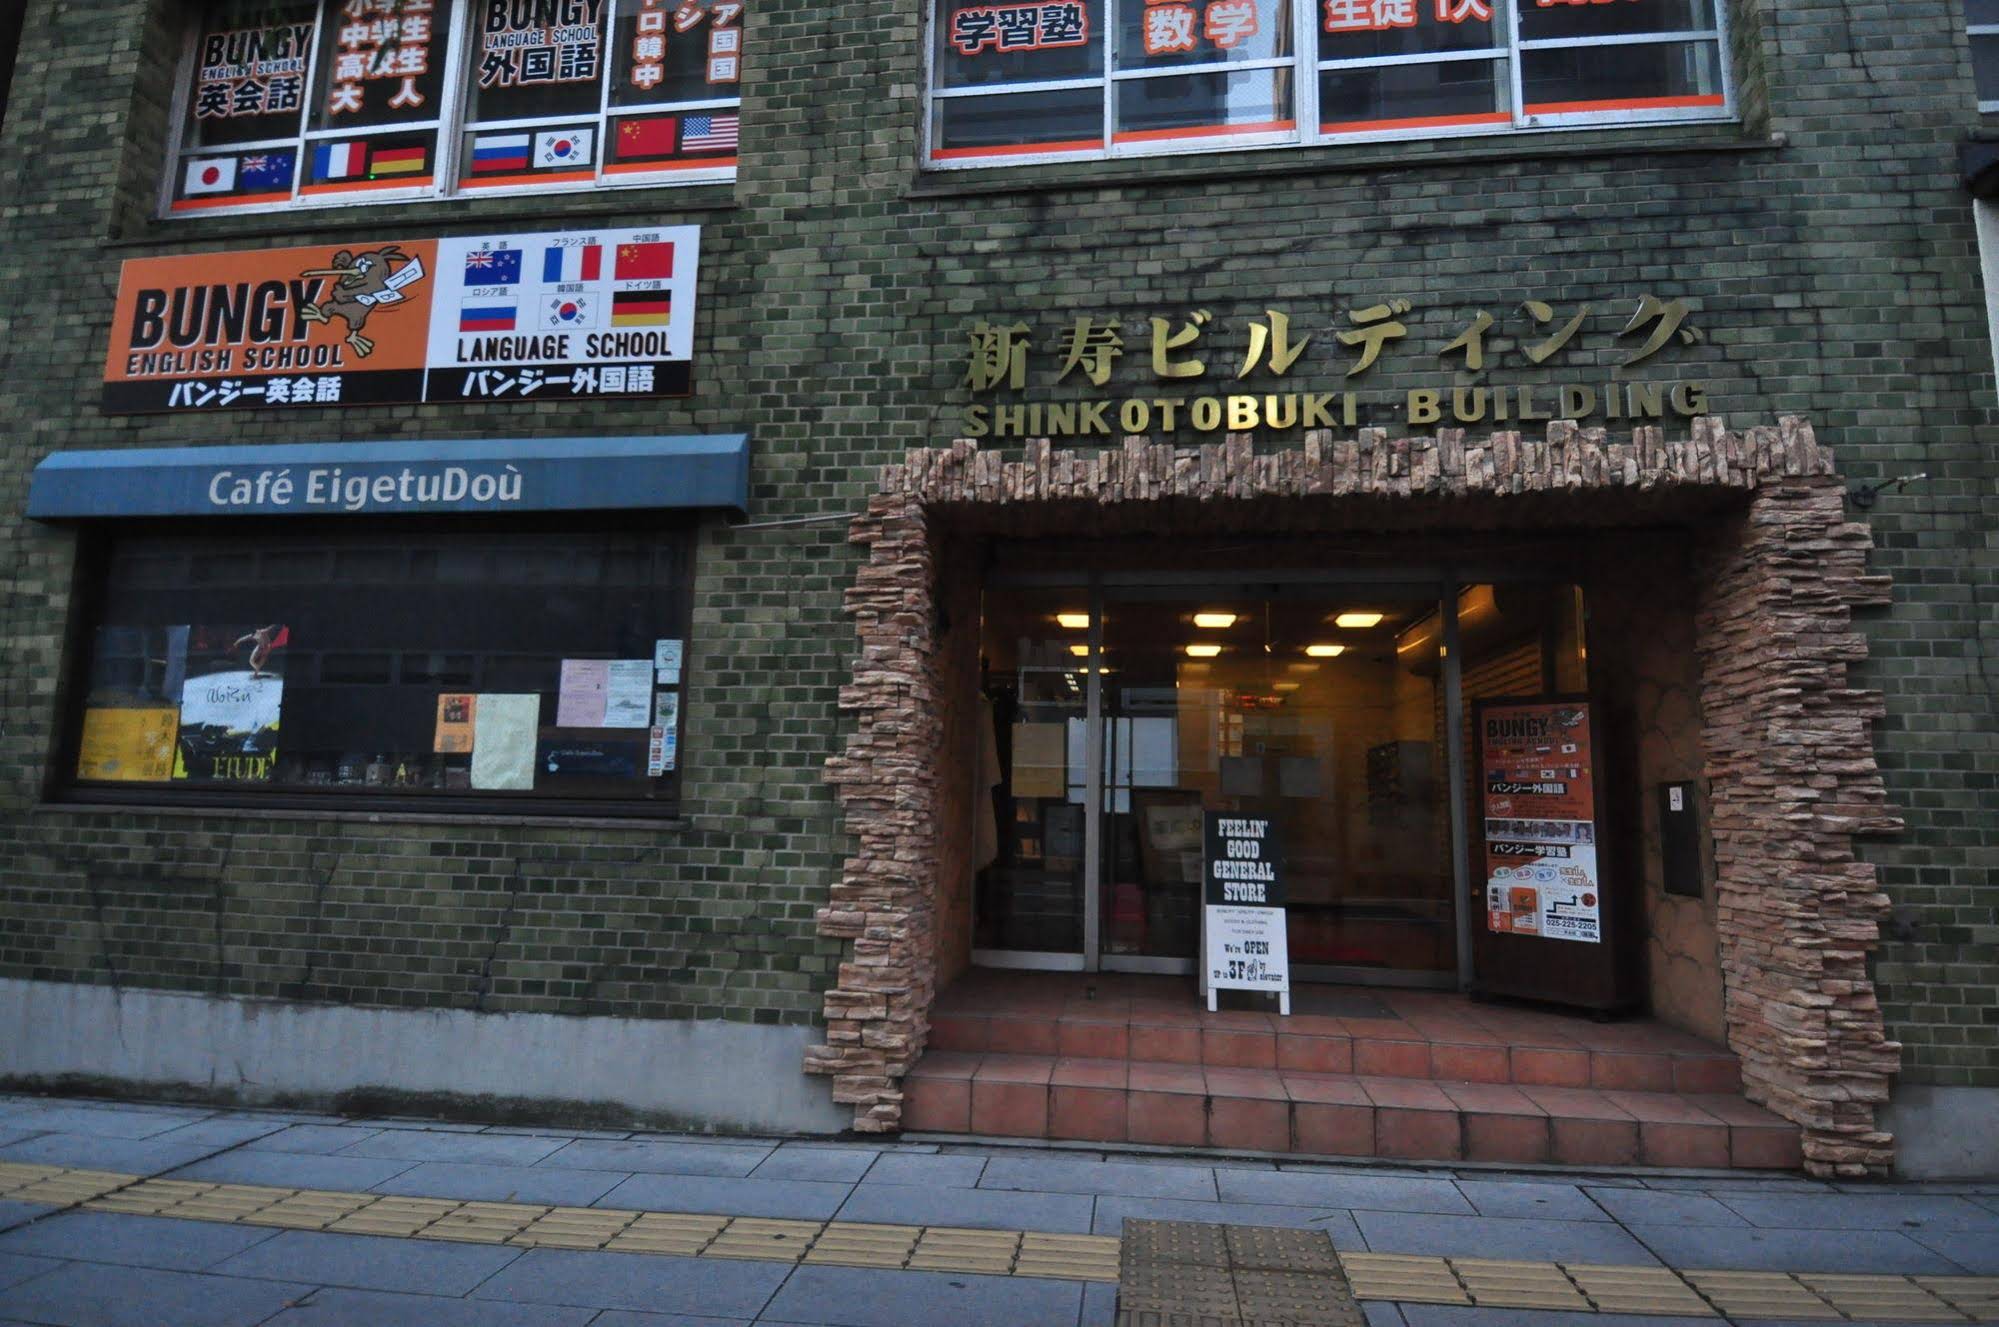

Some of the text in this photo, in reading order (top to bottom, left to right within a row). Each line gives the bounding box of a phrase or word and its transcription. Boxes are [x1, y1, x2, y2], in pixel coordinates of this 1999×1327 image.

[485, 0, 600, 33] BUNGY
[954, 3, 1084, 50] 学習塾
[203, 23, 314, 68] BUNGY
[485, 27, 598, 49] LANGUAGE SCHOOL
[256, 58, 304, 75] SCHOOL
[479, 42, 597, 86] 外国語
[197, 75, 302, 118] 英会話
[553, 236, 597, 248] フランス語
[632, 233, 661, 244] 中国語
[472, 286, 508, 298] ロシア語
[557, 283, 584, 293] 韓国語
[625, 279, 662, 291] ドイツ語
[129, 278, 325, 351] BUNGY
[457, 331, 673, 363] LANGUAGE SCHOOL
[126, 344, 345, 377] ENGLISH SCHOOL
[168, 376, 342, 408] バンジー英会話
[462, 365, 655, 398] バンジー外国語
[960, 381, 1709, 438] SHINKOTOBUKI BUILDING
[208, 465, 523, 511] Café EigetuDoù
[1218, 818, 1269, 839] FEELIN'
[1226, 840, 1260, 859] GOOD
[1213, 860, 1275, 882] GENERAL
[1224, 882, 1266, 903] STORE
[1546, 919, 1597, 931] 025-225-2205
[1244, 940, 1269, 955] OPEN
[1229, 960, 1246, 980] 3F
